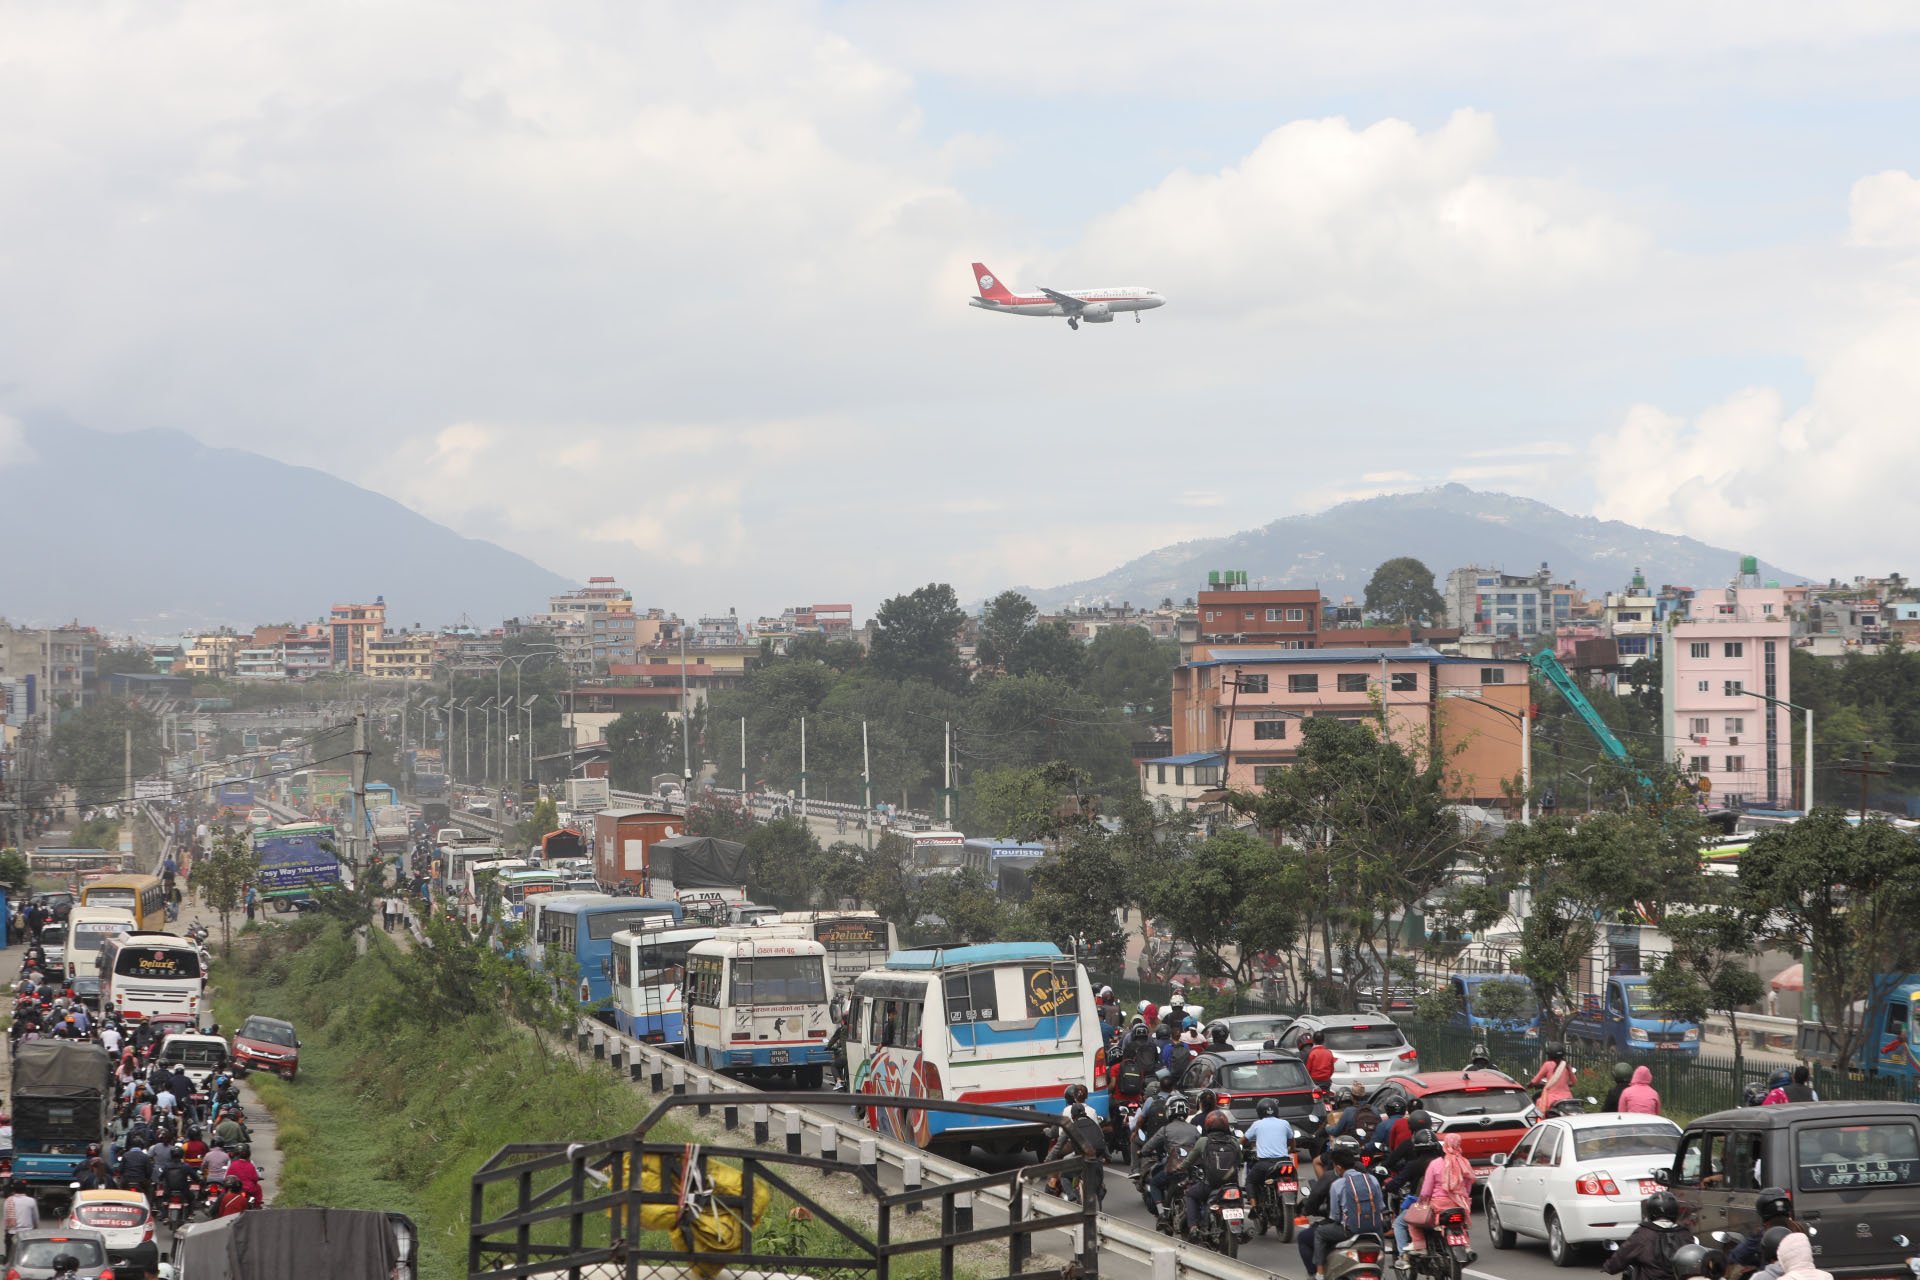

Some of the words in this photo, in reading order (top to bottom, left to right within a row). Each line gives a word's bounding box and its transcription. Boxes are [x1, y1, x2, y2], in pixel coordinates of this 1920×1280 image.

[279, 868, 297, 876] Way
[298, 866, 313, 874] Trial
[314, 864, 337, 872] Center
[1828, 1174, 1855, 1185] OFF
[1857, 1171, 1898, 1183] ROAD
